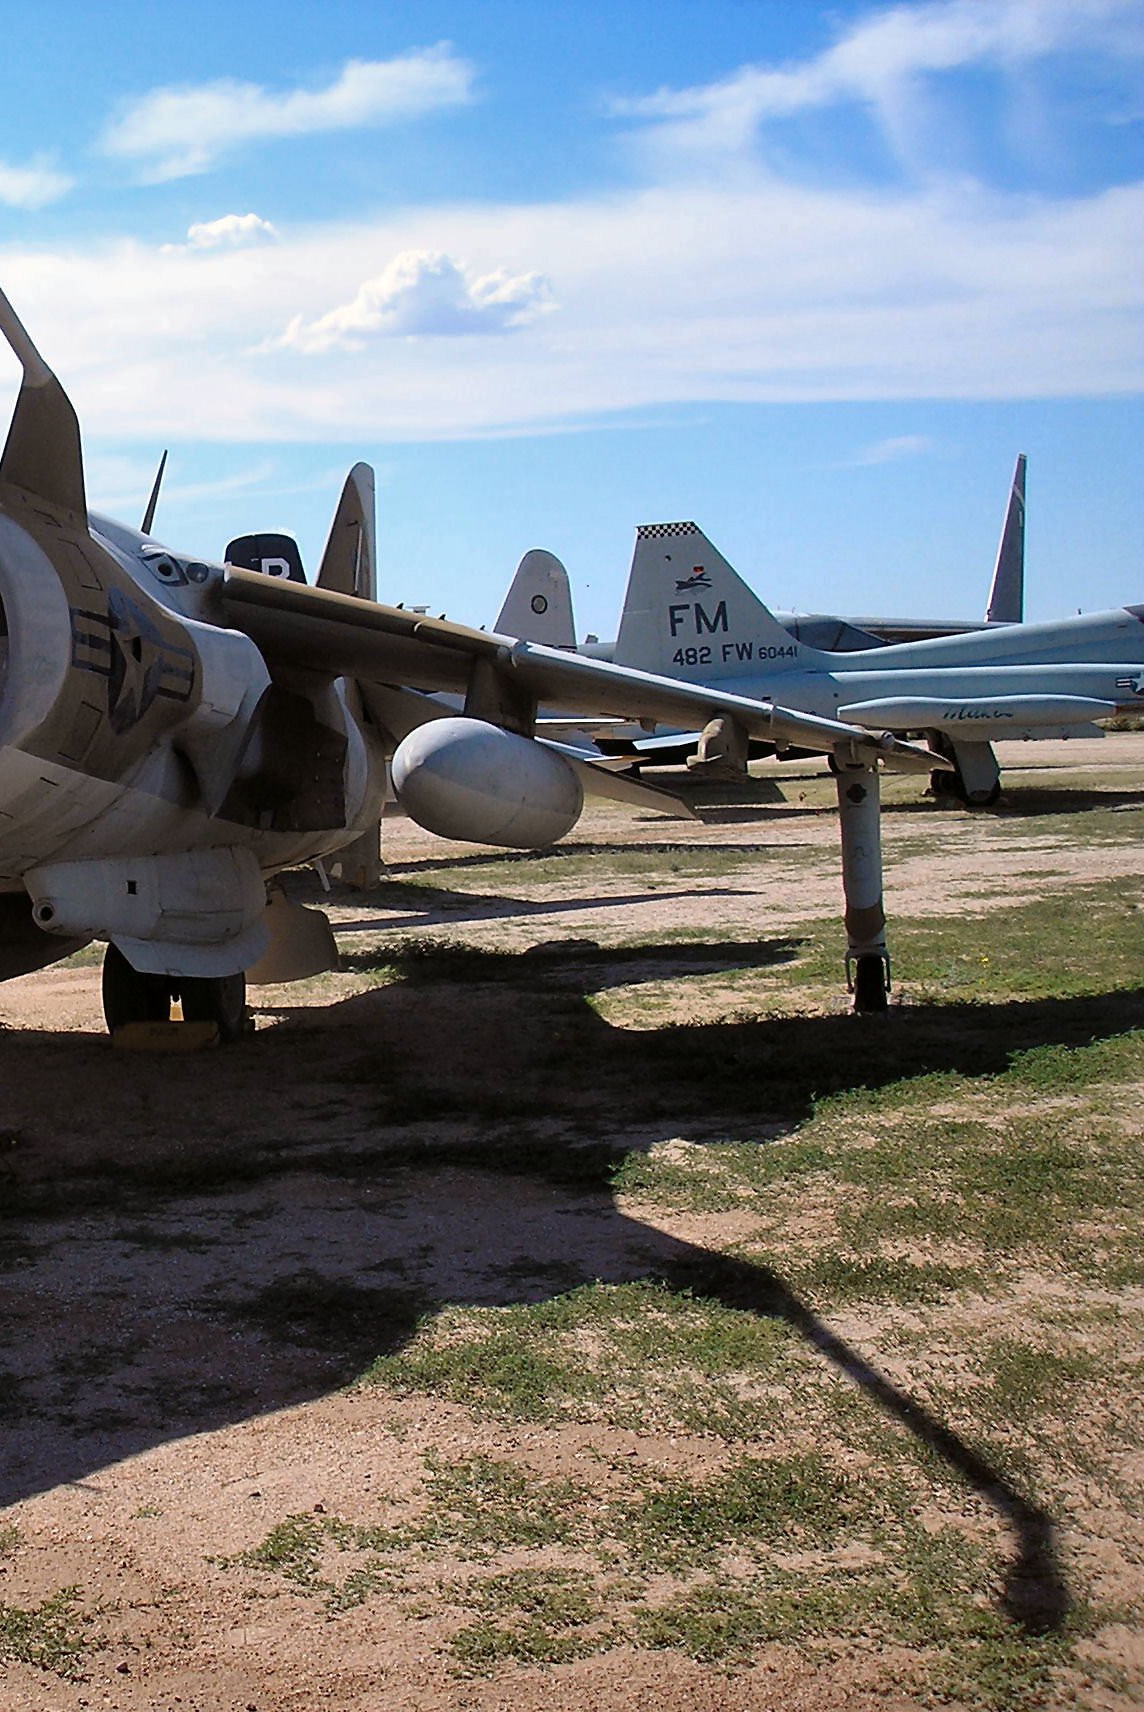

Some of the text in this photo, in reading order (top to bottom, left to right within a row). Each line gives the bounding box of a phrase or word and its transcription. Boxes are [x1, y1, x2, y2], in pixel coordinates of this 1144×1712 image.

[669, 600, 729, 637] FM
[672, 642, 798, 666] 482 FW 60441
